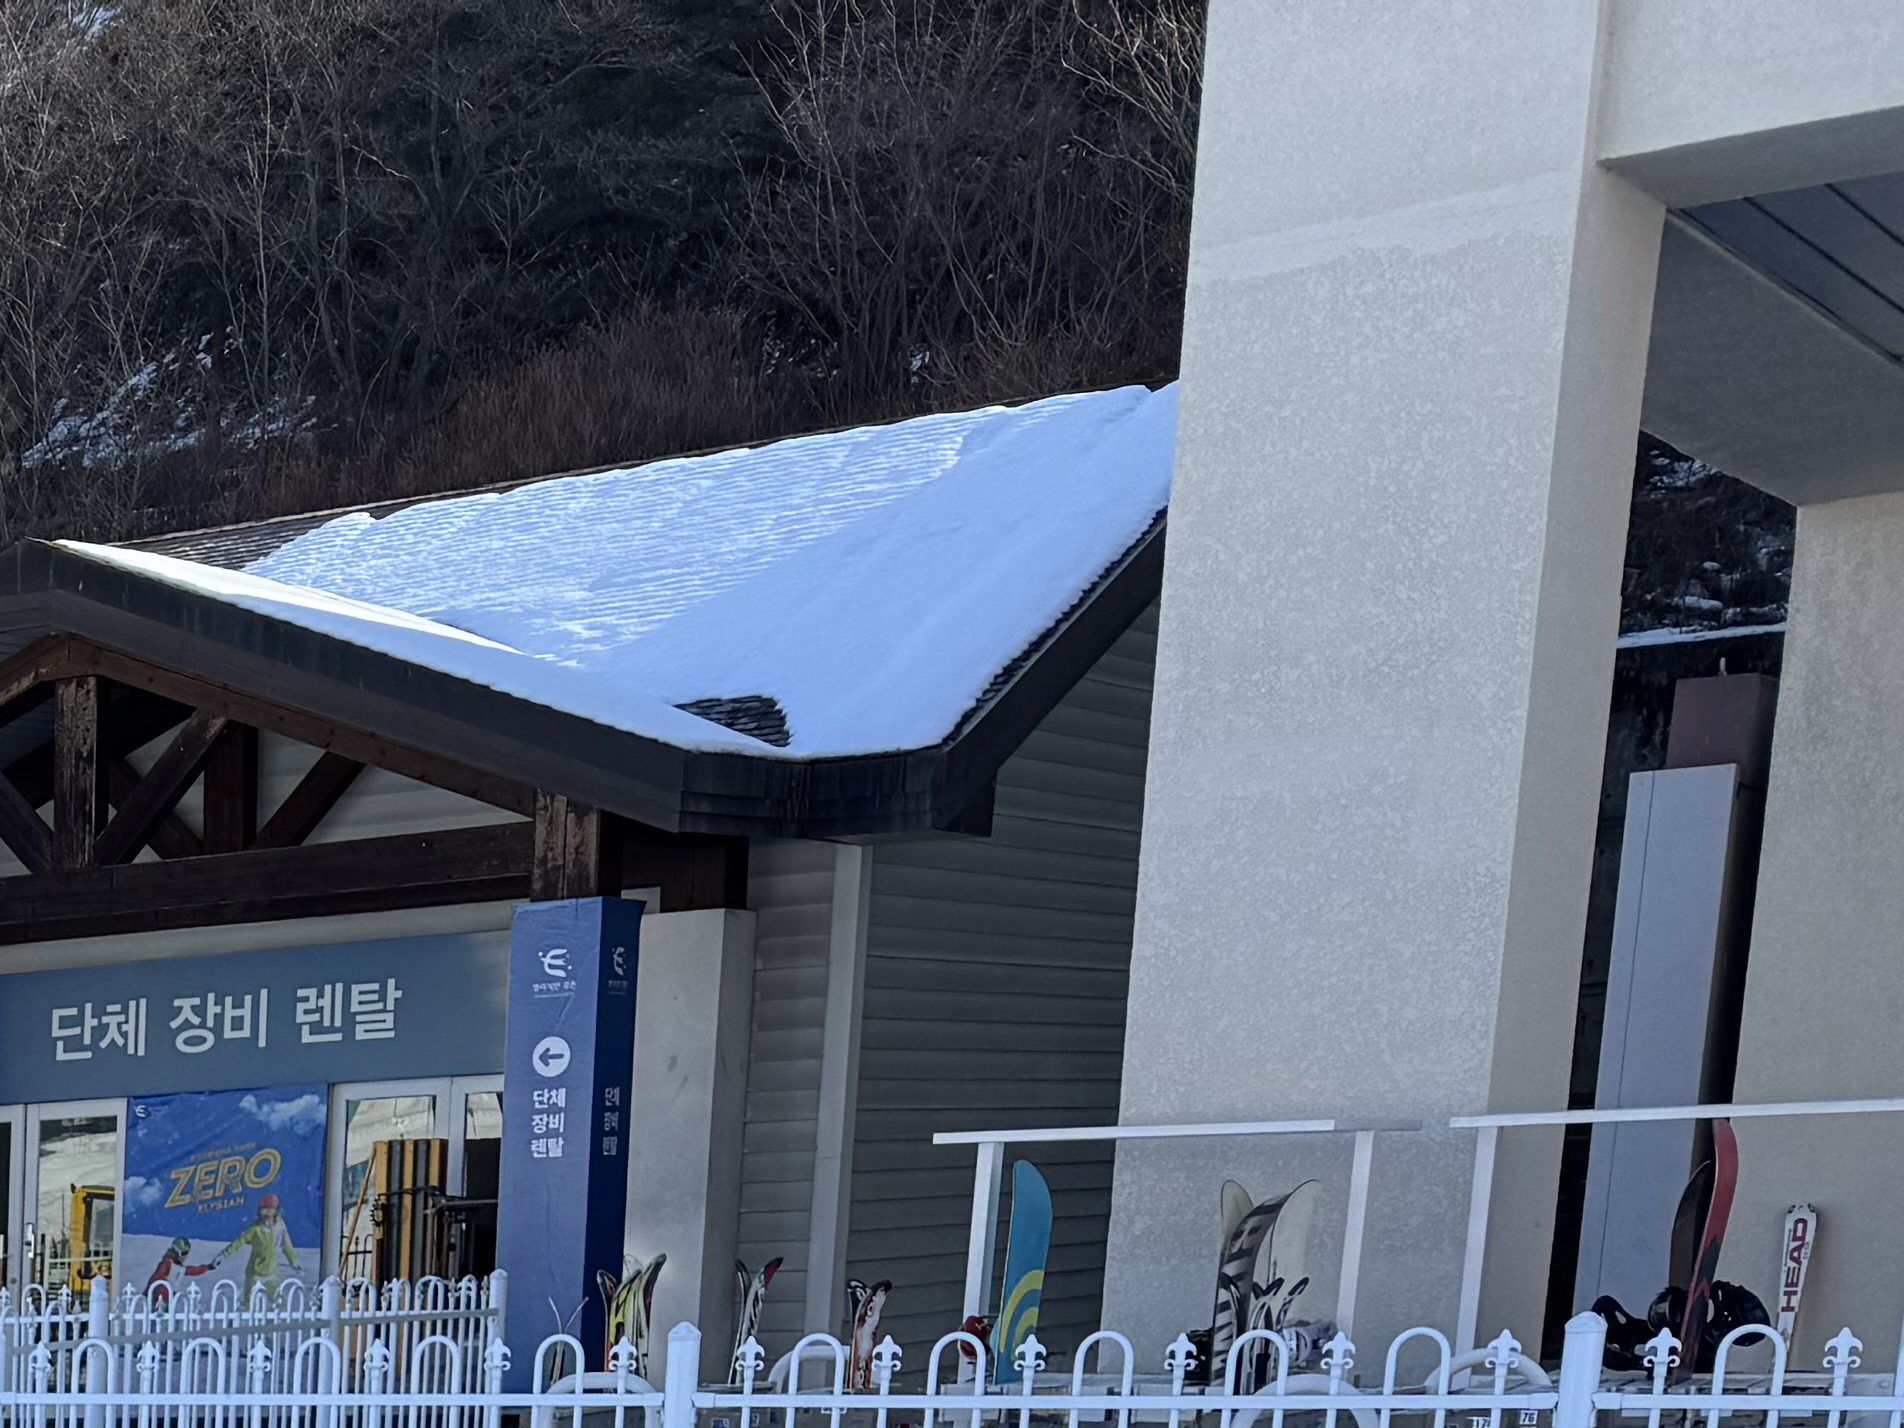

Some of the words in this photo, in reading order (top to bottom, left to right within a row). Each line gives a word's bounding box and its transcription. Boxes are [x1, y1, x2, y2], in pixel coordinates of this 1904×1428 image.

[51, 997, 147, 1061] 단체
[169, 988, 268, 1054] 장비
[295, 978, 403, 1044] 렌탈
[533, 1087, 566, 1109] 단체
[532, 1112, 565, 1134] 장비
[531, 1137, 564, 1158] 렌탈
[164, 1148, 282, 1208] ZERO
[1781, 1218, 1808, 1312] HEAD
